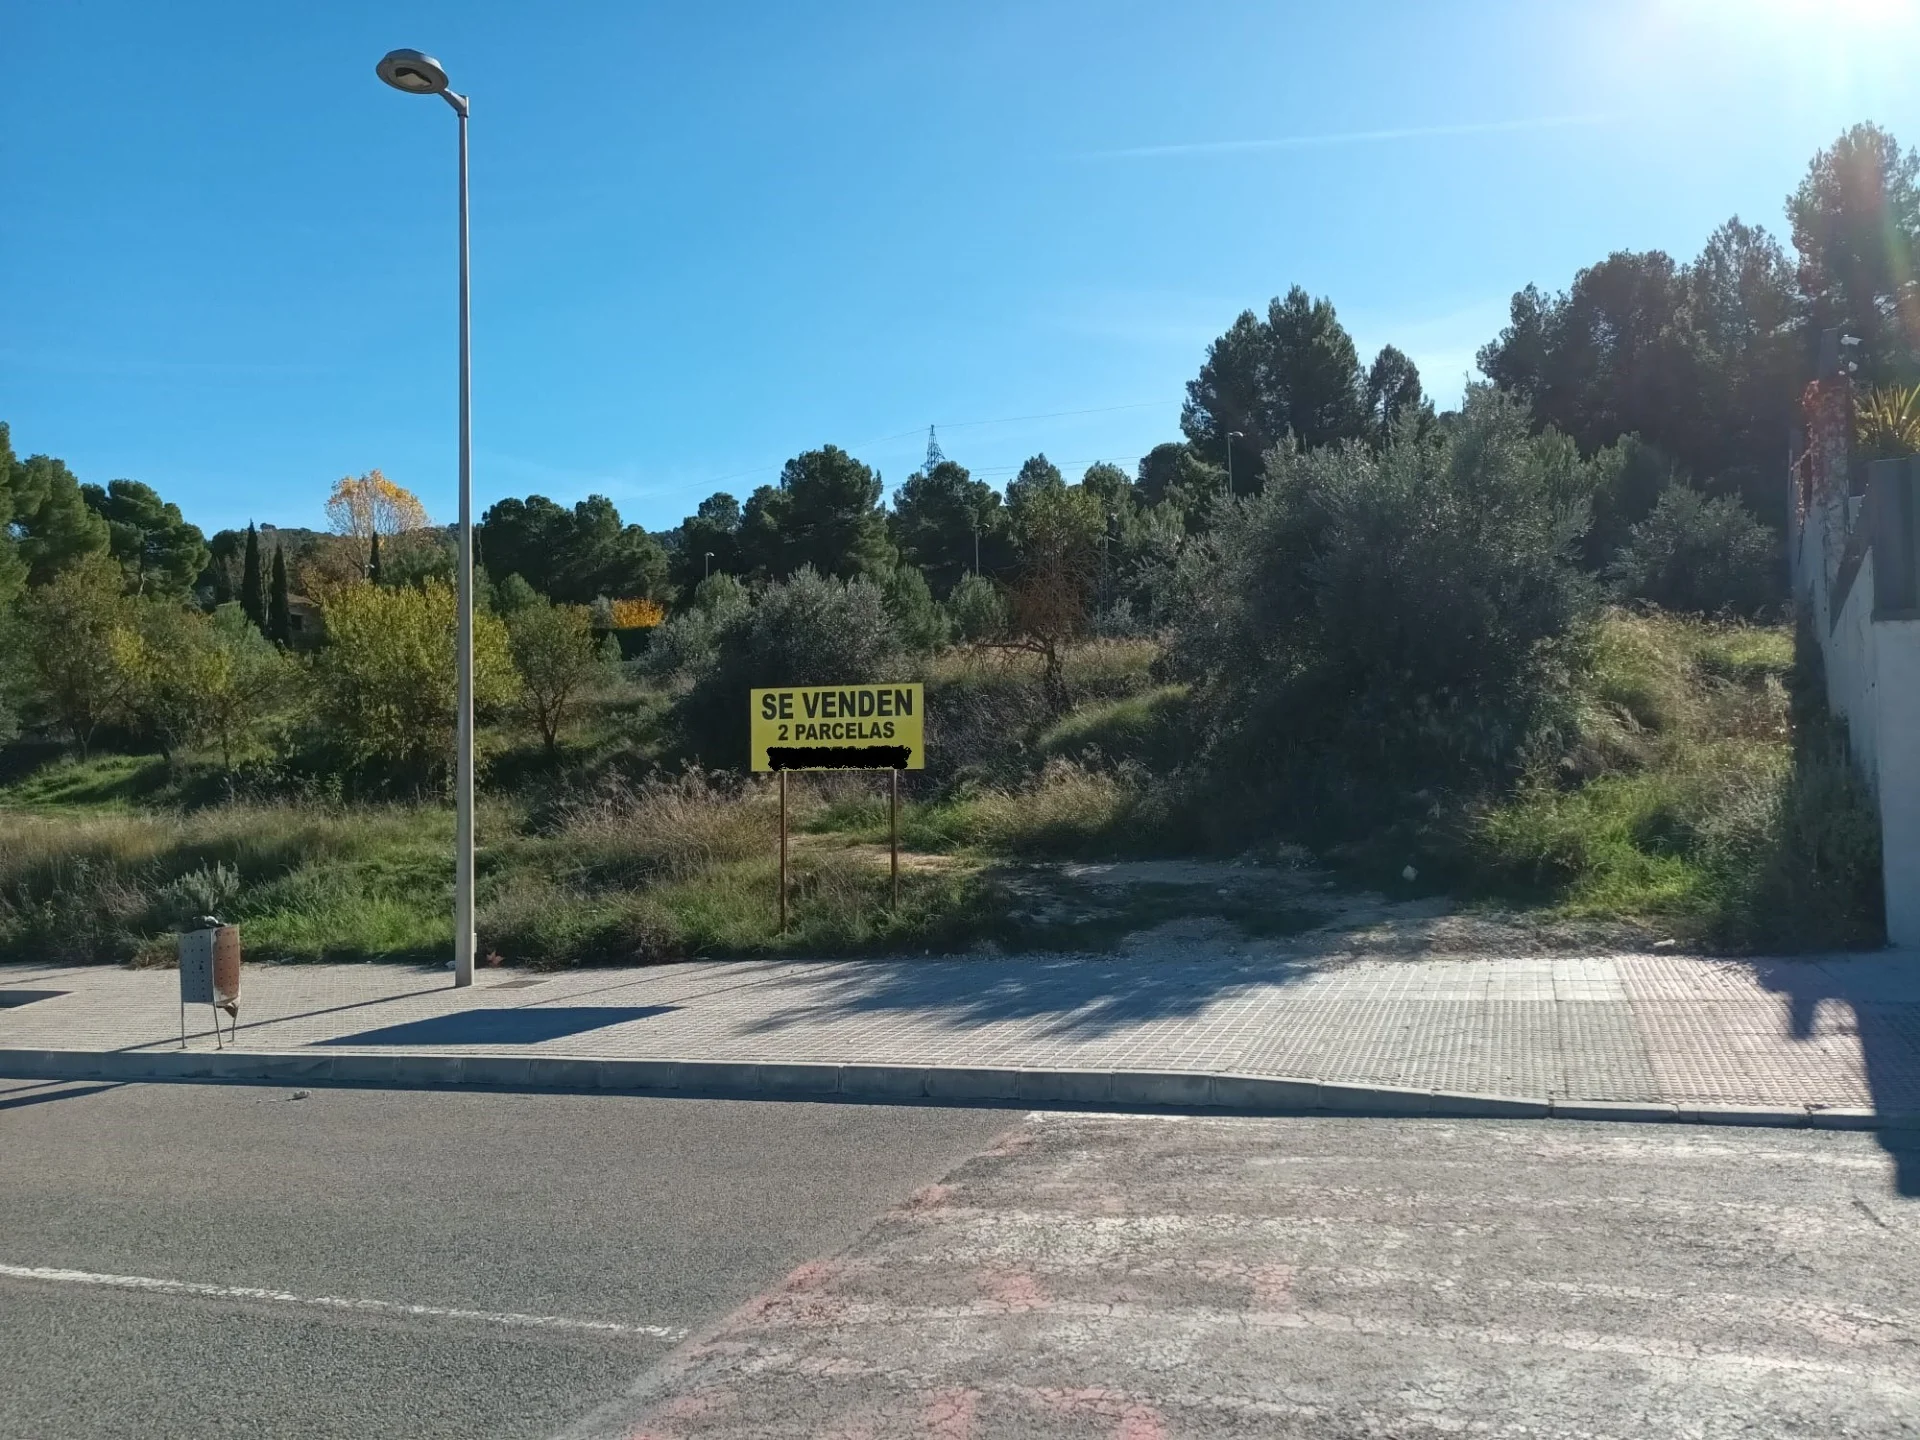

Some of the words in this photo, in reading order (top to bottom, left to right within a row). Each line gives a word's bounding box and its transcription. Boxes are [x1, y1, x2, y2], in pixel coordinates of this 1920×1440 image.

[761, 693, 794, 720] SE
[802, 689, 913, 718] VENDEN
[778, 724, 789, 741] 2
[795, 721, 895, 741] PARCELAS
